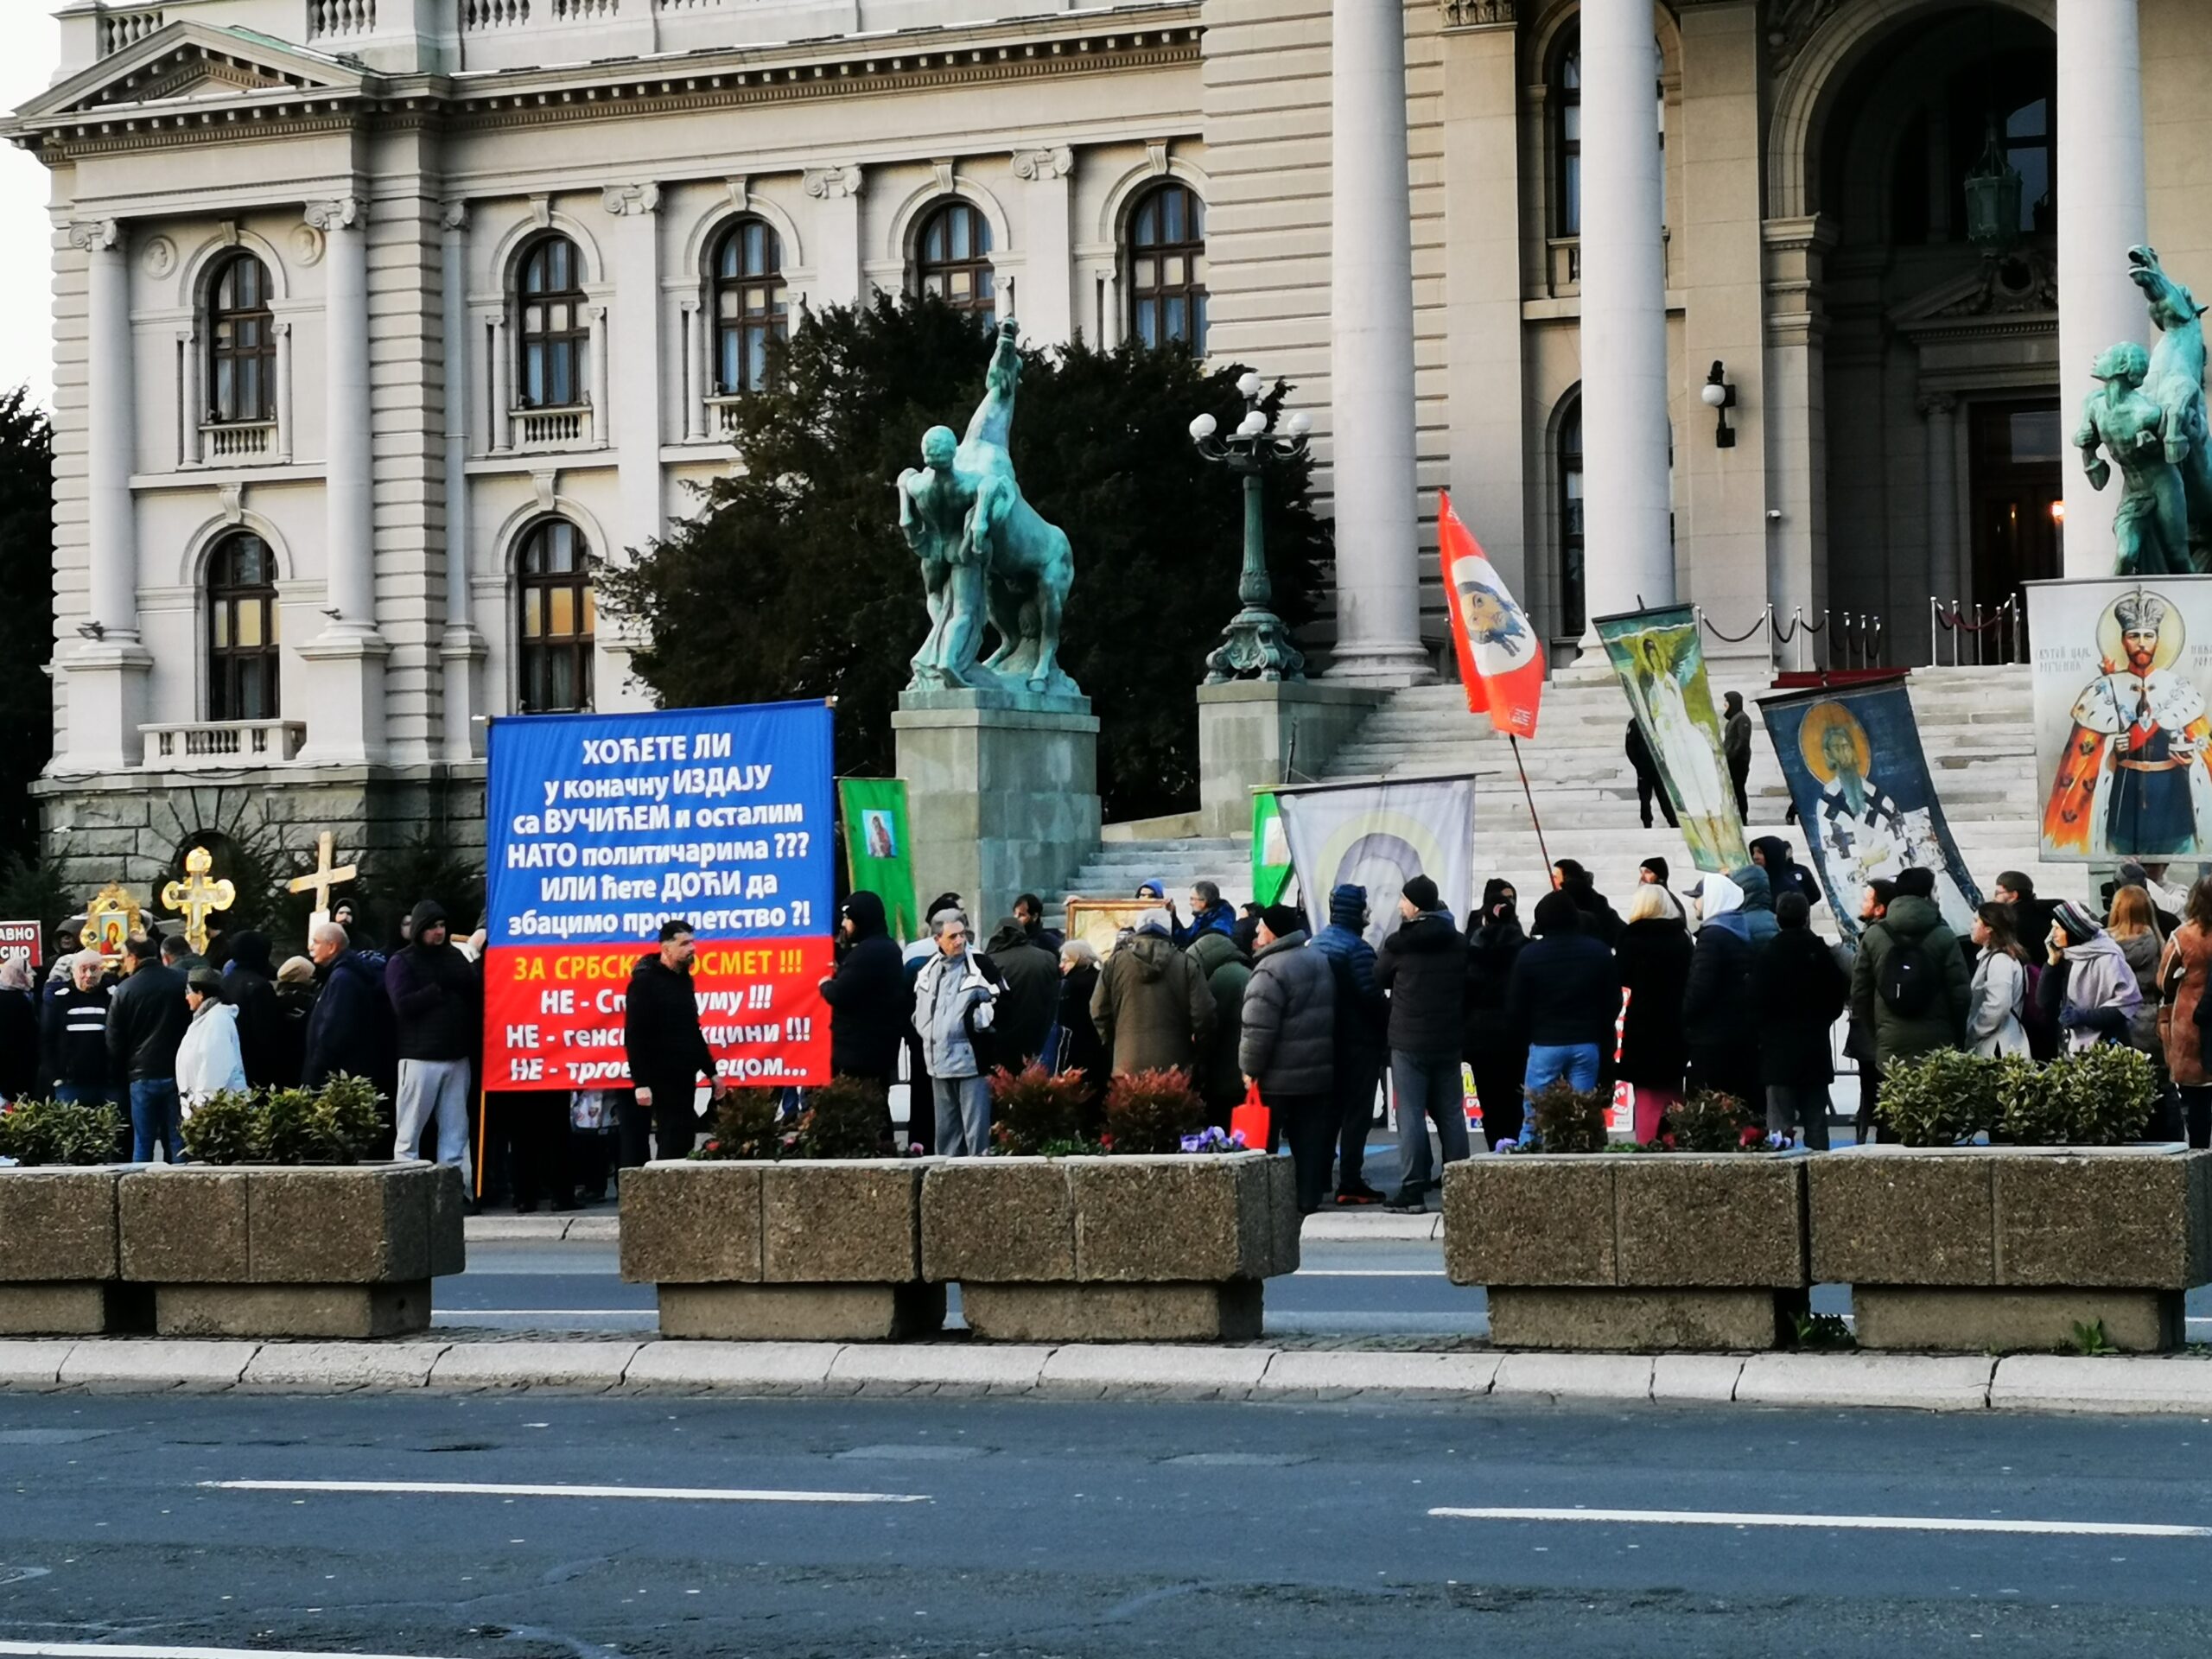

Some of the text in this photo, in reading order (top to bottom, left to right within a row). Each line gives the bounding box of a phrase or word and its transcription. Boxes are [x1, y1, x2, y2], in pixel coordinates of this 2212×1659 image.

[582, 733, 731, 765] ХОЋЕТЕ ЛИ
[544, 764, 772, 806] у коначну ИЗДАЈУ
[513, 802, 803, 835] са ВУЧИЋЕМ и осталим
[508, 831, 810, 868] НАТО политичарима ???
[541, 870, 778, 903] ИЛИ ћете ДОЋИ да
[508, 909, 619, 939] збацимо
[791, 900, 810, 926] ?!
[514, 948, 802, 981] ЗА СРБСК СМЕТ !!!
[541, 989, 575, 1014] НЕ
[748, 984, 772, 1009] !!!
[506, 1025, 540, 1048] НЕ
[702, 1024, 779, 1048] цини
[786, 1017, 810, 1041] !!!
[511, 1058, 543, 1081] НЕ
[715, 1058, 807, 1081] ецом...
